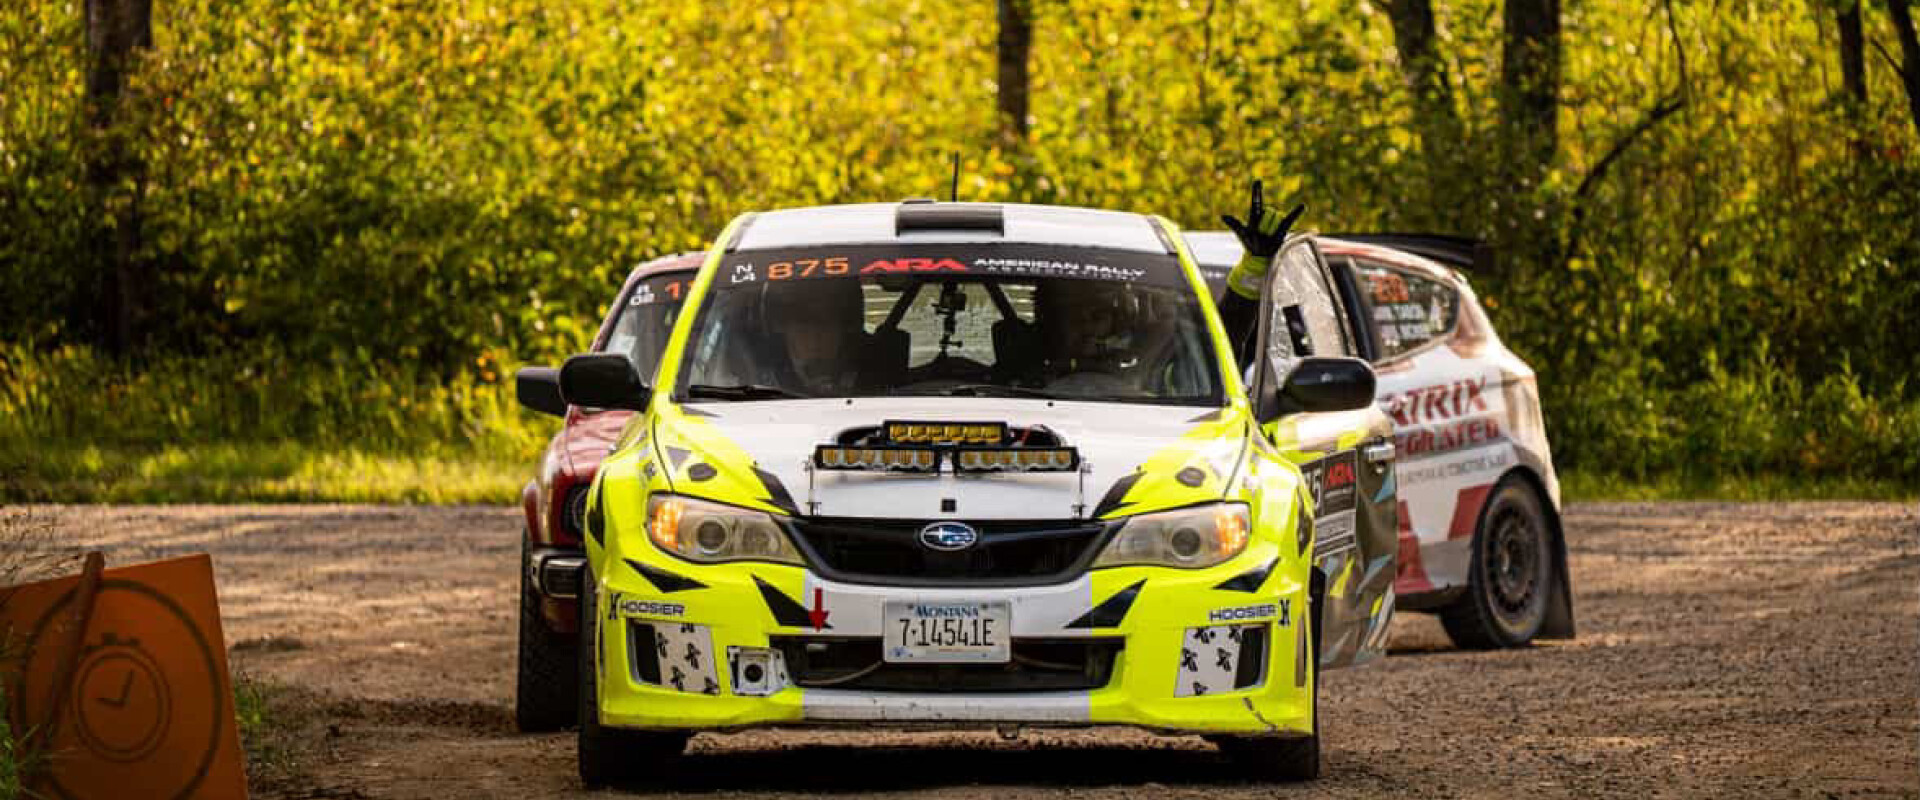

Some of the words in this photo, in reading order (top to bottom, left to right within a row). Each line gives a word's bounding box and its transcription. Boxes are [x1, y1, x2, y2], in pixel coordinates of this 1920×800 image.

[735, 263, 753, 274] N
[767, 257, 849, 280] 875
[860, 257, 967, 272] ARA
[975, 258, 1080, 270] AMERICAN
[1084, 262, 1146, 277] RALLY
[731, 271, 756, 283] L4
[619, 601, 685, 615] HOOSIER
[1208, 604, 1276, 622] HOOSIER
